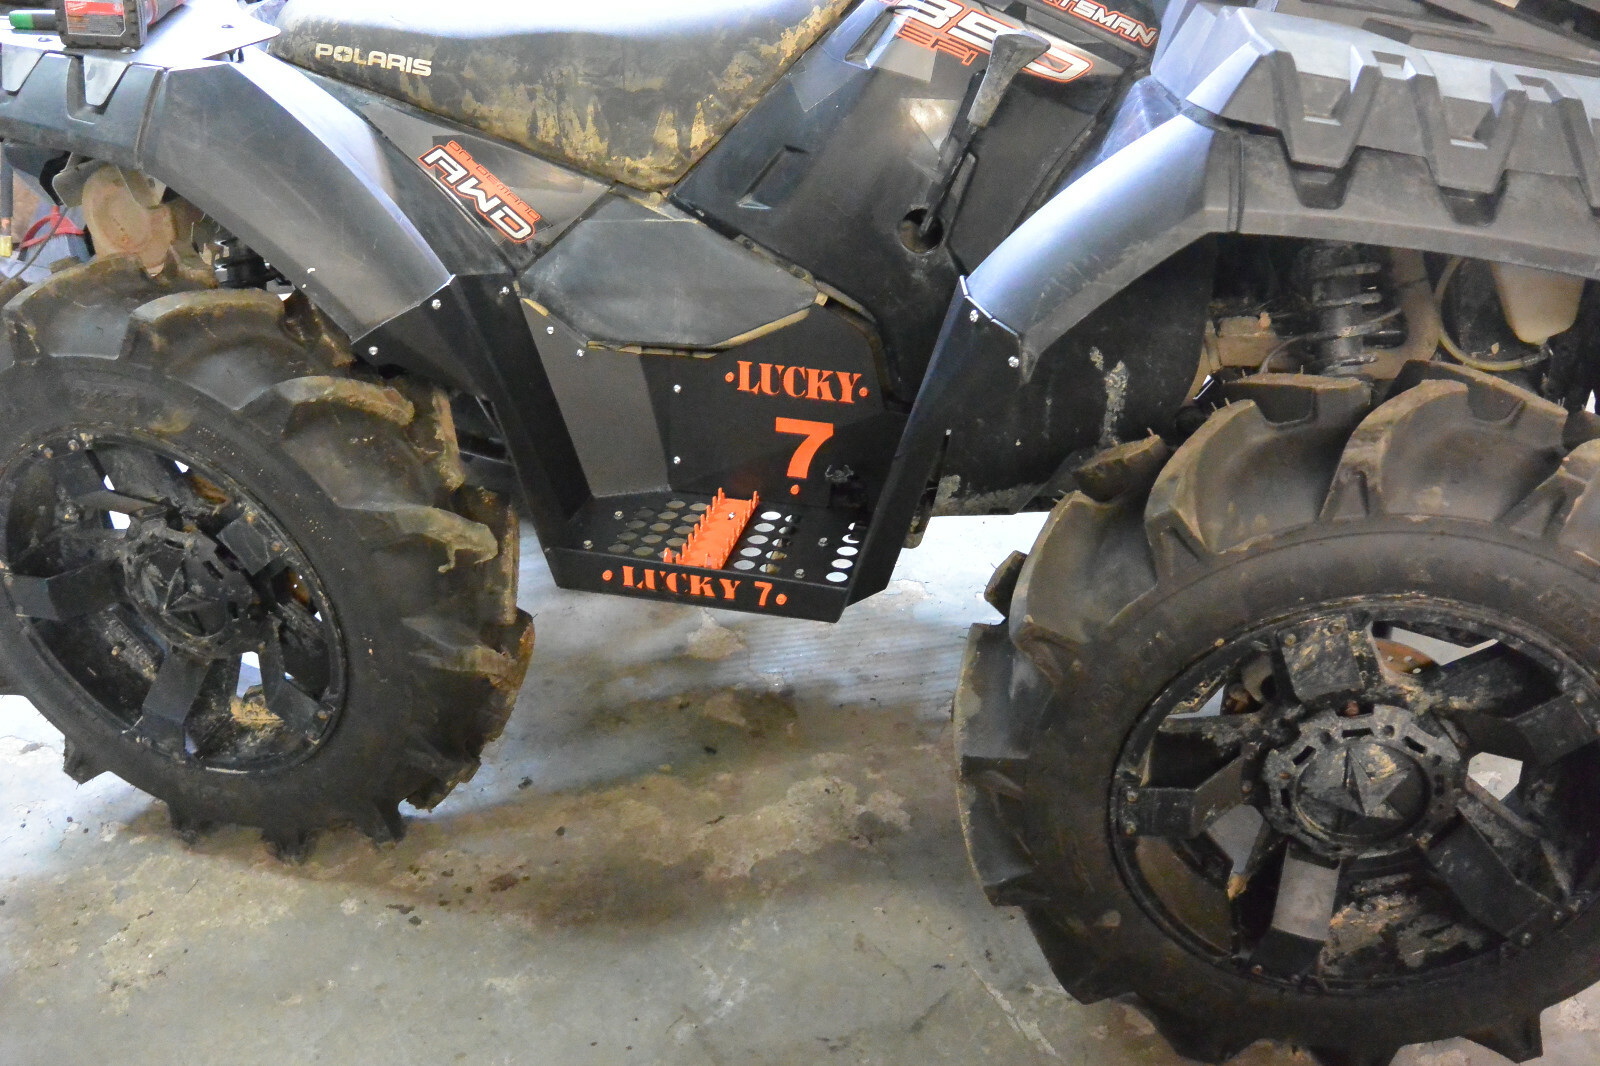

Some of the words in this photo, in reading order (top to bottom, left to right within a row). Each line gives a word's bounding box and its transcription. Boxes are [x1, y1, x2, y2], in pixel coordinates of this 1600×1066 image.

[315, 43, 432, 77] POLARIS
[897, 22, 978, 66] EFI
[422, 147, 533, 240] AWD
[448, 140, 473, 162] ON
[476, 164, 541, 221] DEMAND
[736, 360, 863, 404] LUCKY
[775, 416, 834, 479] 7
[622, 565, 741, 600] LUCKY
[754, 580, 773, 607] 7
